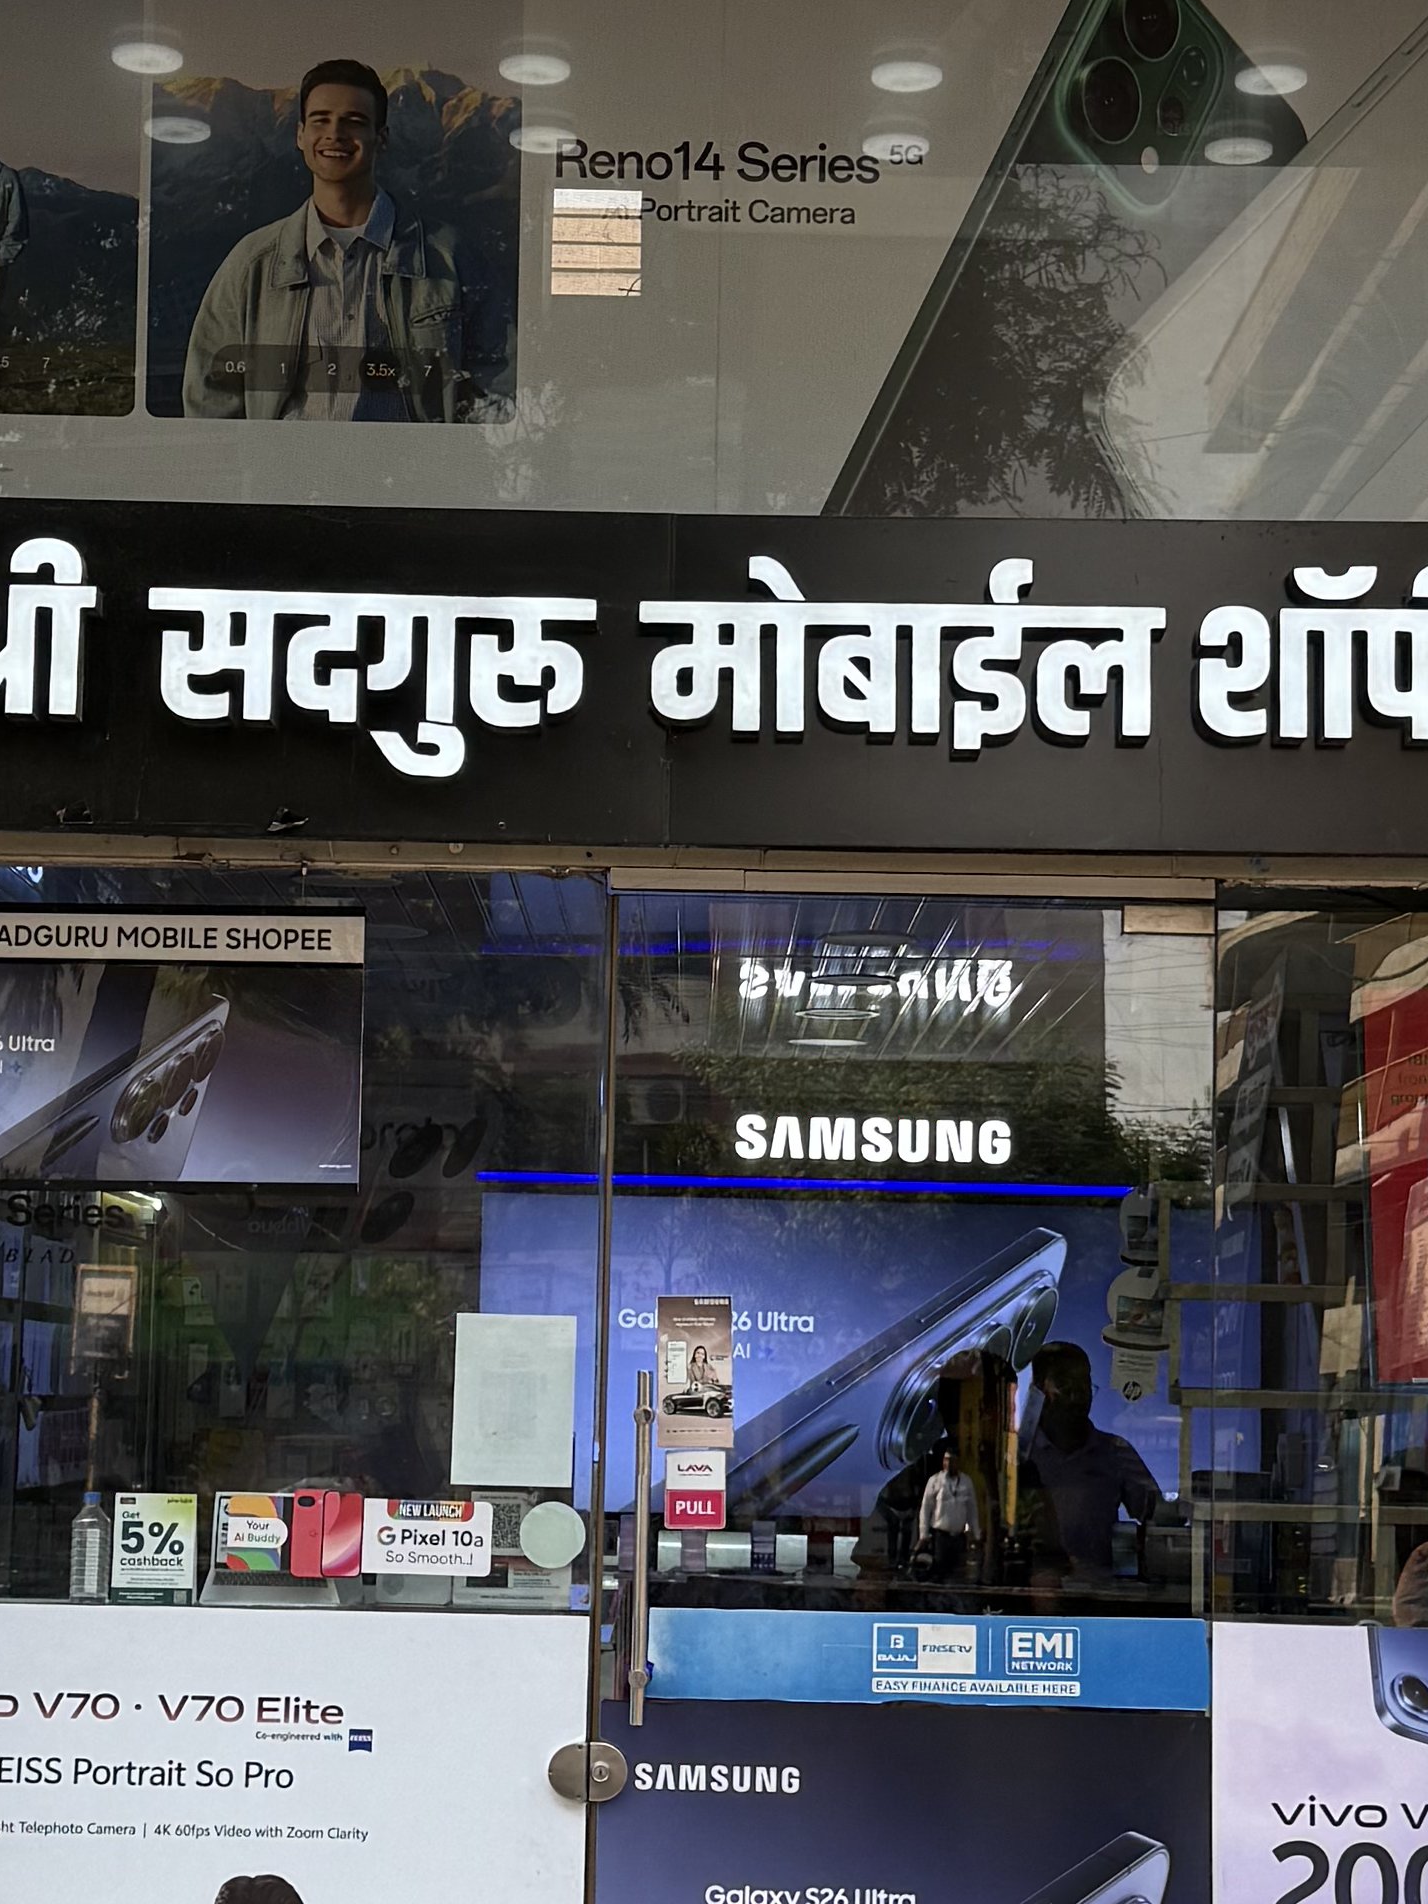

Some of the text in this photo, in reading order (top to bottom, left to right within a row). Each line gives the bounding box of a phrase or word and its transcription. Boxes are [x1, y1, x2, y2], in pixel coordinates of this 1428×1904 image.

[553, 138, 924, 184] Reno14 Series 5G
[641, 197, 741, 224] Portrait
[748, 199, 856, 225] Camera
[149, 586, 600, 780] सदगुरू
[638, 556, 1166, 756] मोबाईल
[117, 926, 219, 950] MOBILE
[225, 927, 332, 952] SHOPEE
[8, 1035, 55, 1053] Ultra
[735, 1114, 1012, 1165] SAMSUNG
[5, 1192, 126, 1228] Series
[678, 1464, 713, 1473] LAVA
[122, 1511, 140, 1519] Get
[399, 1504, 462, 1518] NEW LAUNCH
[676, 1501, 715, 1515] PULL
[246, 1520, 270, 1530] Your
[121, 1521, 184, 1555] 5%
[234, 1533, 281, 1544] AI Buddy
[401, 1529, 484, 1547] Pixel 10a
[120, 1556, 183, 1567] cashback
[386, 1551, 403, 1563] So
[1011, 1632, 1074, 1659] EMI
[1011, 1661, 1073, 1672] NETWORK
[876, 1681, 1076, 1694] EASY FINANCE AVAILABLE HERE
[33, 1692, 119, 1720] V70
[158, 1694, 244, 1723] V70
[256, 1696, 344, 1725] Elite
[255, 1731, 343, 1742] Co-engineered with
[73, 1757, 186, 1788] Portrait
[196, 1760, 233, 1788] So
[244, 1762, 293, 1789] Pro
[634, 1763, 800, 1794] SAMSUNG
[1272, 1795, 1387, 1829] vivo
[19, 1821, 83, 1837] Telephoto
[87, 1822, 136, 1835] Camera
[154, 1824, 172, 1836] 4K
[175, 1824, 210, 1839] 60fps
[214, 1824, 251, 1838] Video
[255, 1826, 283, 1838] with
[286, 1827, 323, 1839] Zoom
[327, 1827, 369, 1842] Clarity
